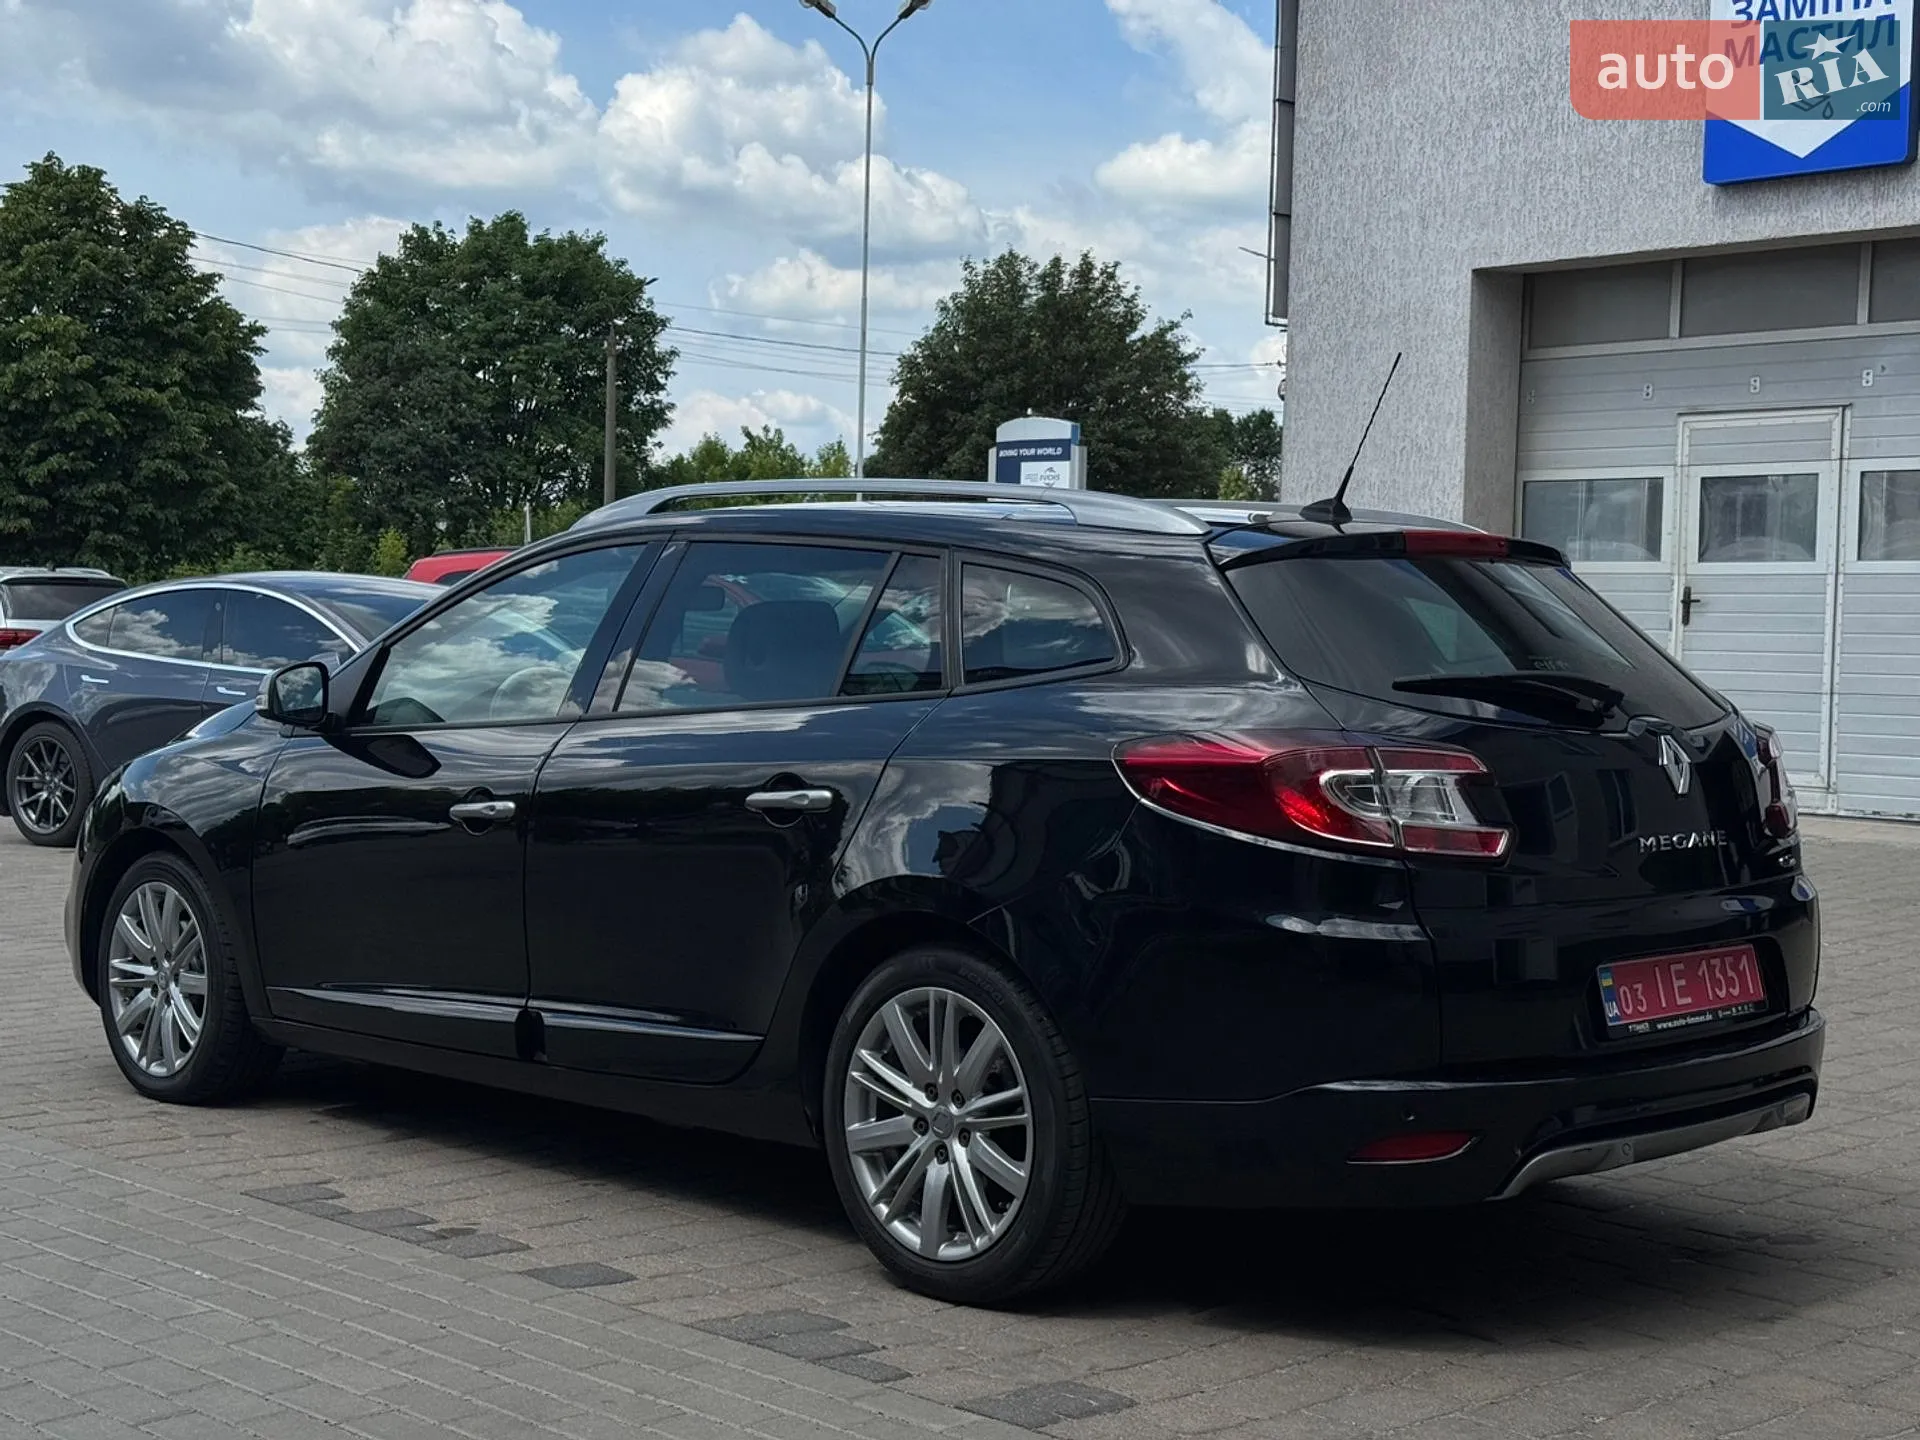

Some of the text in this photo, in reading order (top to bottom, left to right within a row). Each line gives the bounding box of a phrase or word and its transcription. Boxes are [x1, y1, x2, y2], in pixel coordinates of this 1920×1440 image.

[1019, 447, 1036, 456] YOUR
[1037, 447, 1063, 456] WORLD
[1638, 830, 1728, 853] MEGANE
[1619, 954, 1754, 1015] 03 IE 1351
[1605, 1001, 1621, 1018] UA
